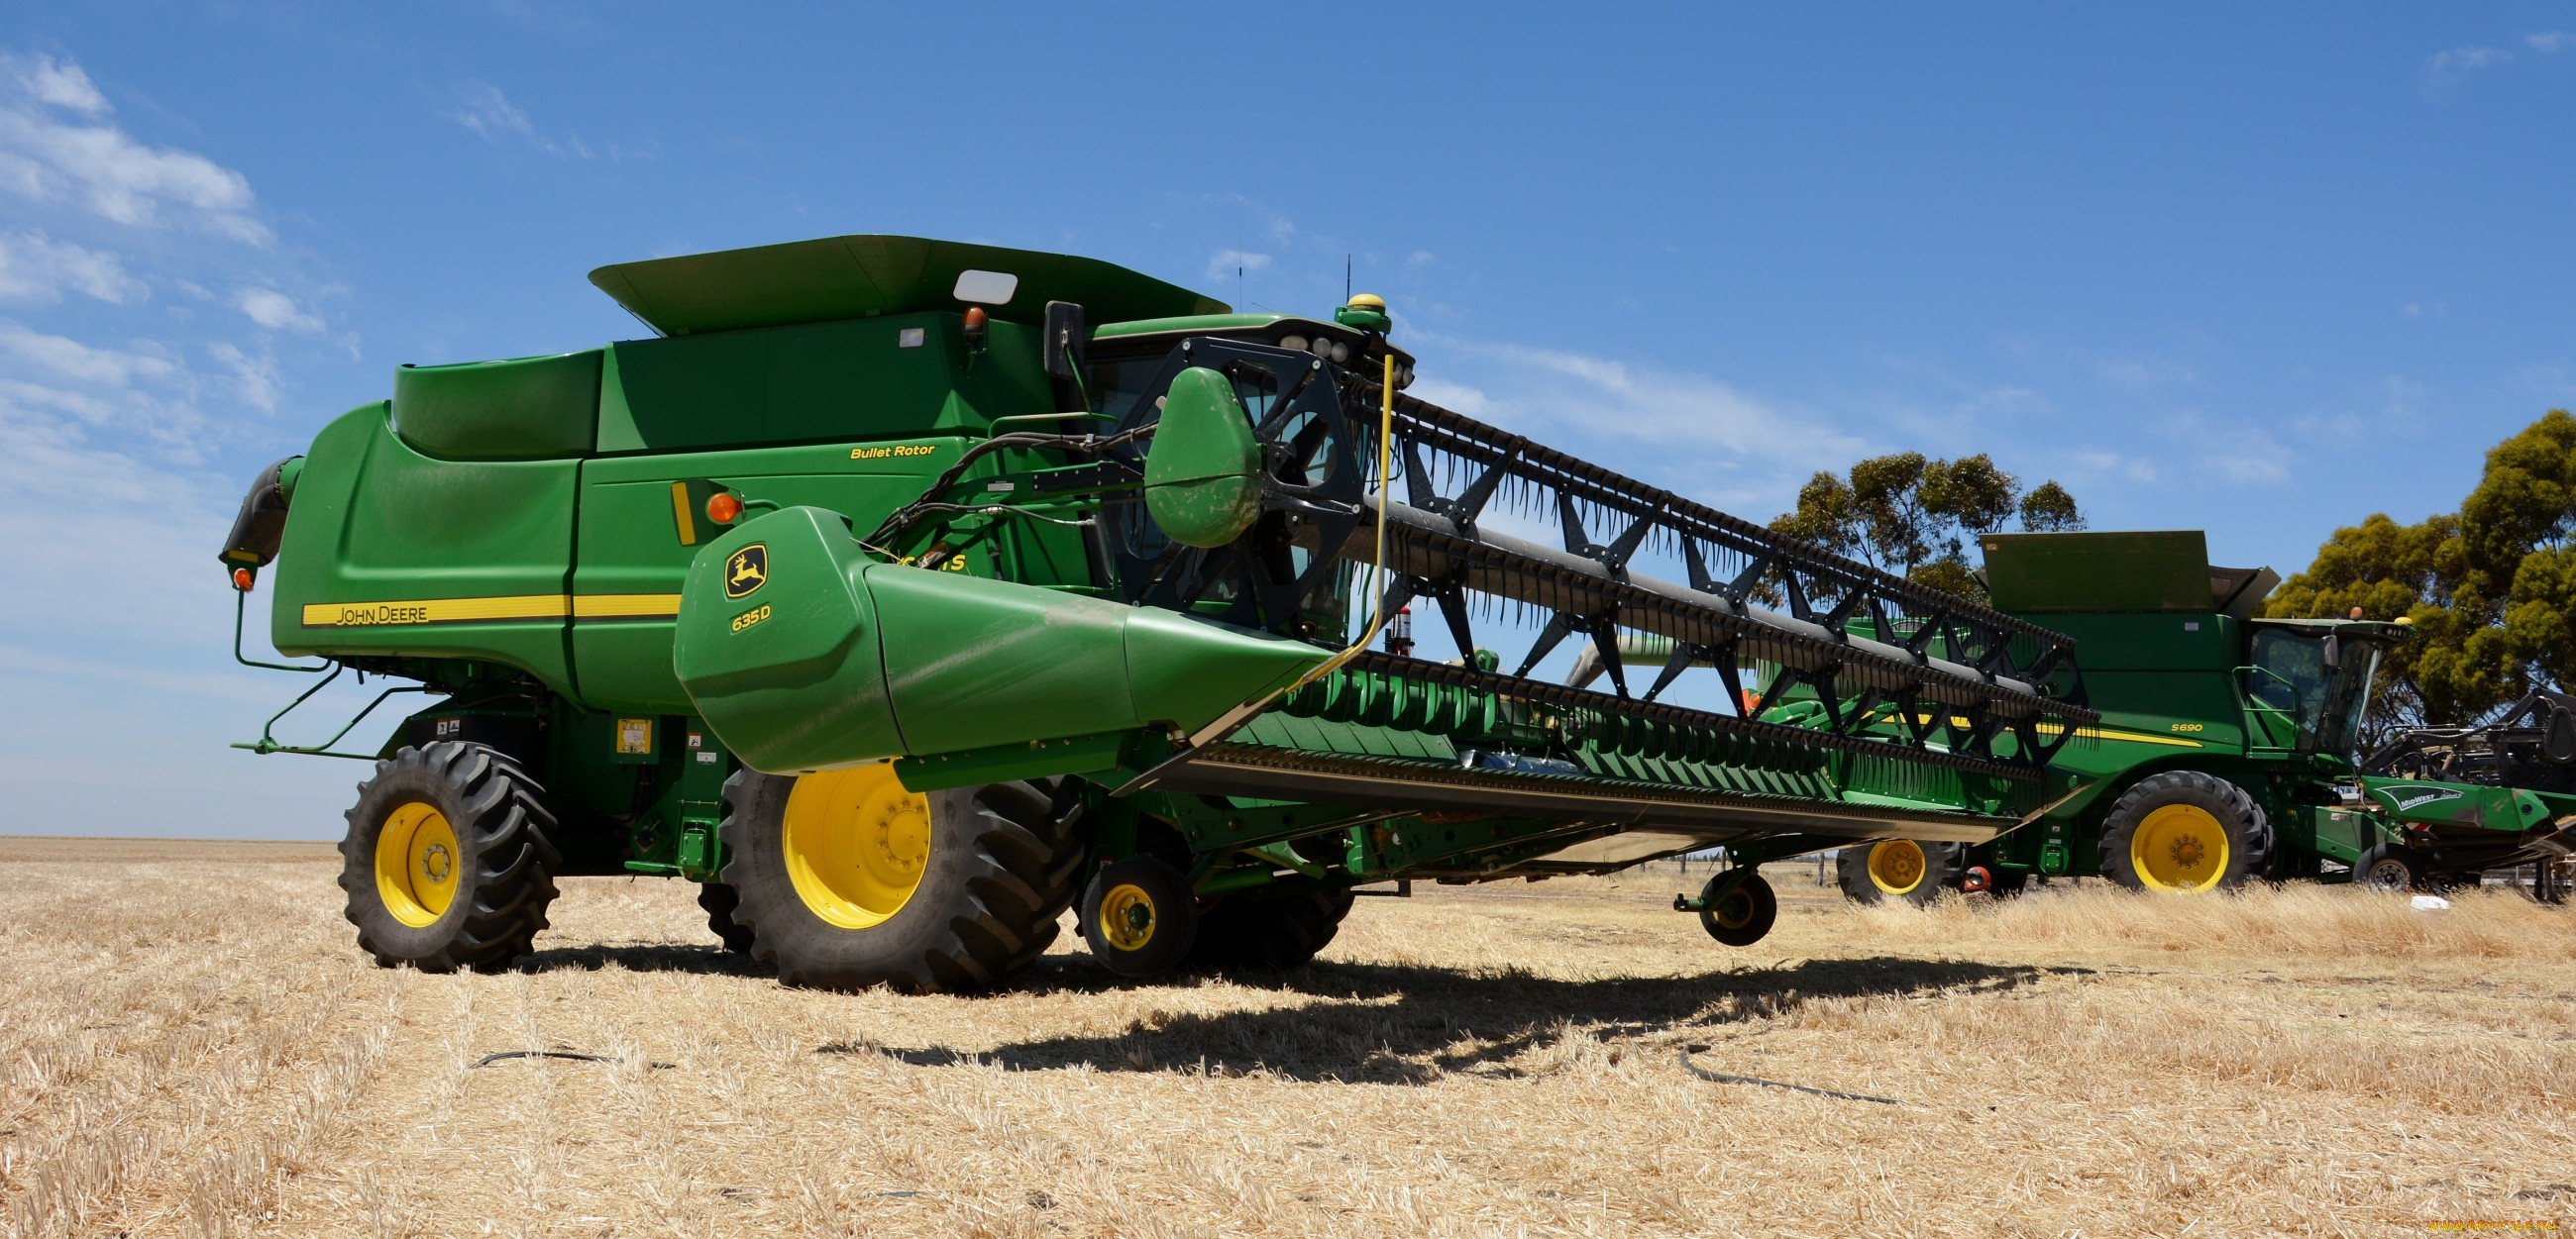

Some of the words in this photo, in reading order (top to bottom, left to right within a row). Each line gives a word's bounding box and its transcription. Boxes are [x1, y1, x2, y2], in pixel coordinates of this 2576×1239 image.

[850, 447, 892, 460] Bullet
[894, 444, 935, 457] Rotor
[337, 607, 376, 623] JOHN
[378, 605, 427, 622] DEERE
[2171, 723, 2203, 732] S690
